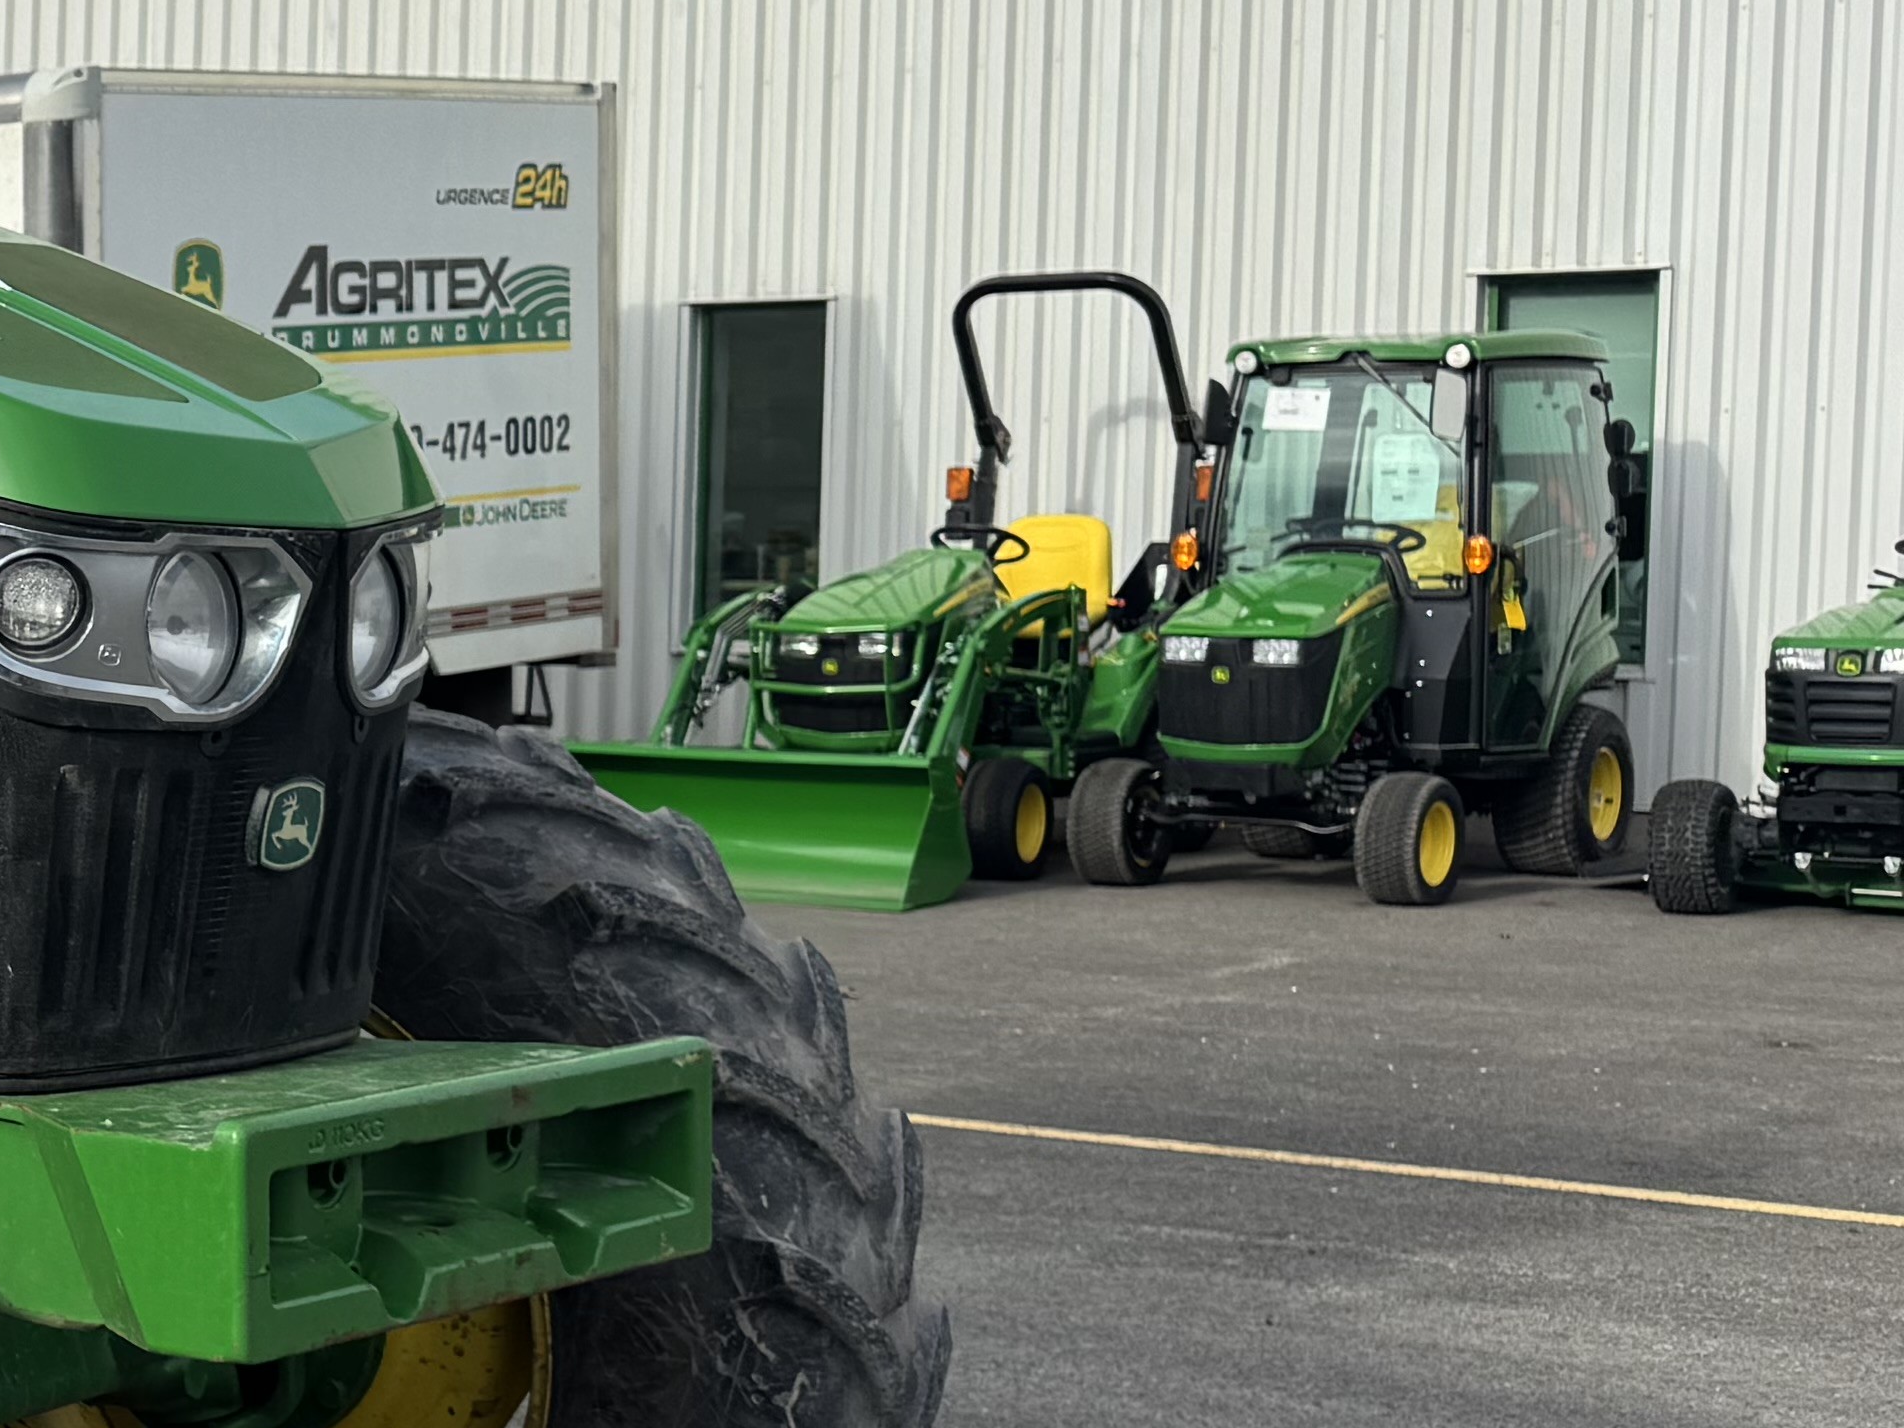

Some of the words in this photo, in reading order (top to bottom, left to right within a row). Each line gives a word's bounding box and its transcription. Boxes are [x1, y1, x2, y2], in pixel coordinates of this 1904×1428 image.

[436, 188, 510, 206] URGENCE
[512, 163, 569, 209] 24h
[272, 244, 511, 319] AGRITEX
[474, 504, 519, 527] JOHN
[519, 497, 568, 522] DEERE
